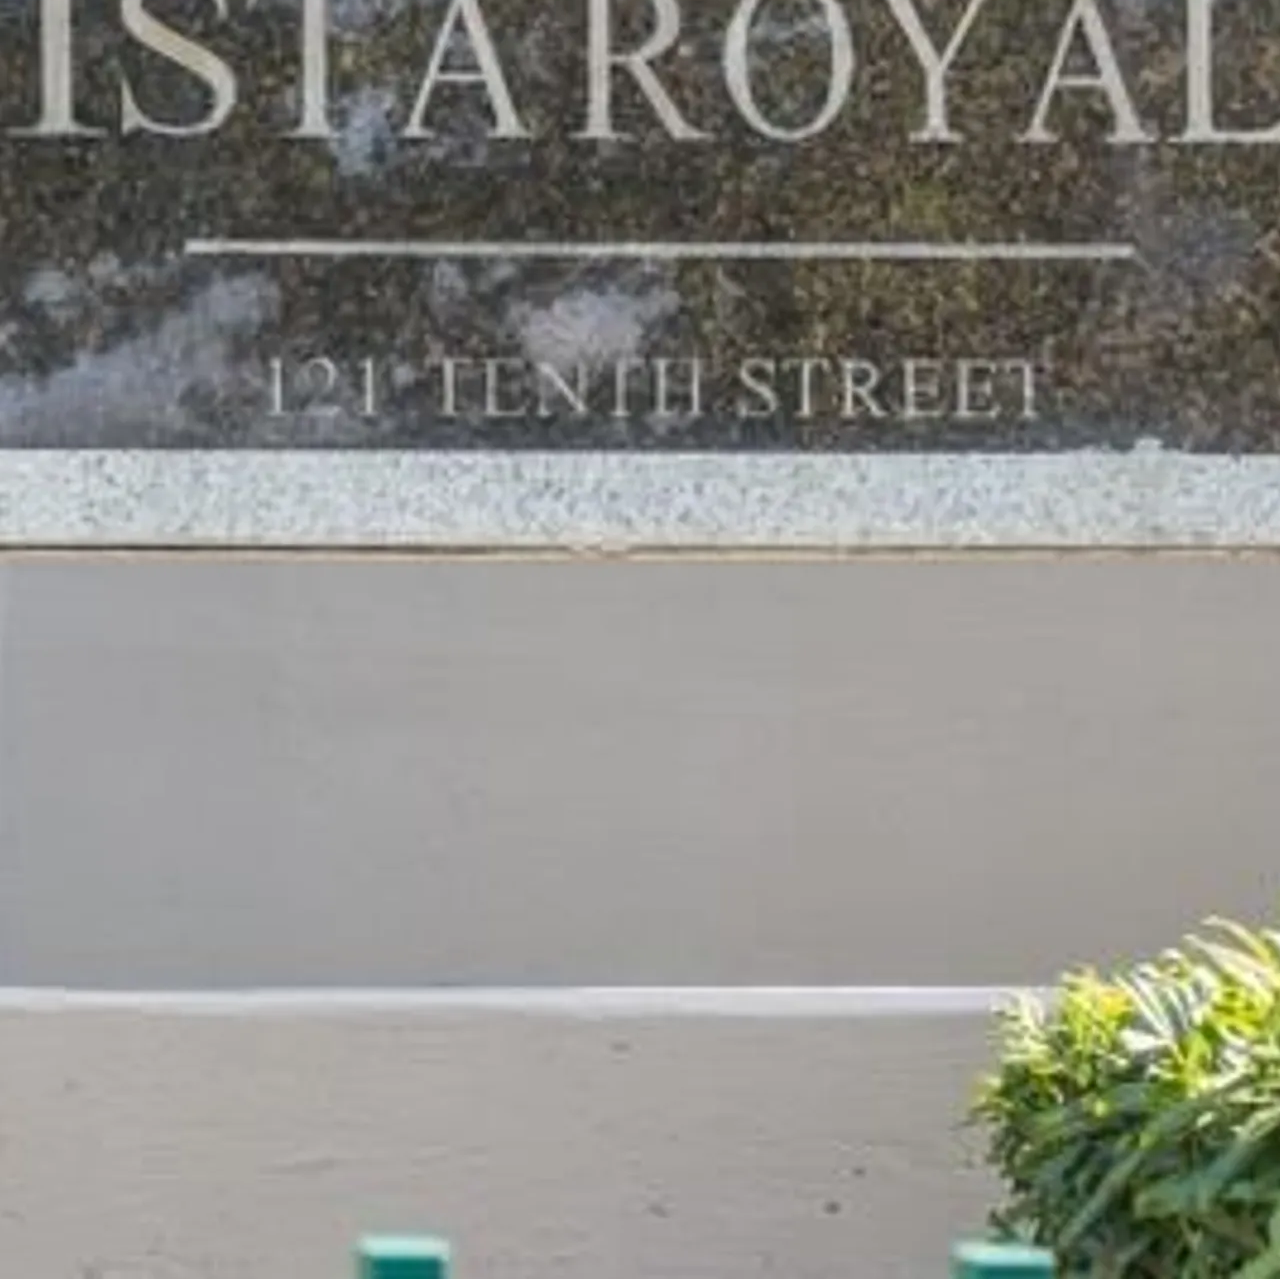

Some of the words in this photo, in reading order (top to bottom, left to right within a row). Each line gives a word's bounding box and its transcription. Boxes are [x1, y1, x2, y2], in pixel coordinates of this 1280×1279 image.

[266, 357, 380, 418] 121
[423, 357, 704, 418] TENTH
[737, 357, 1042, 419] STREET
